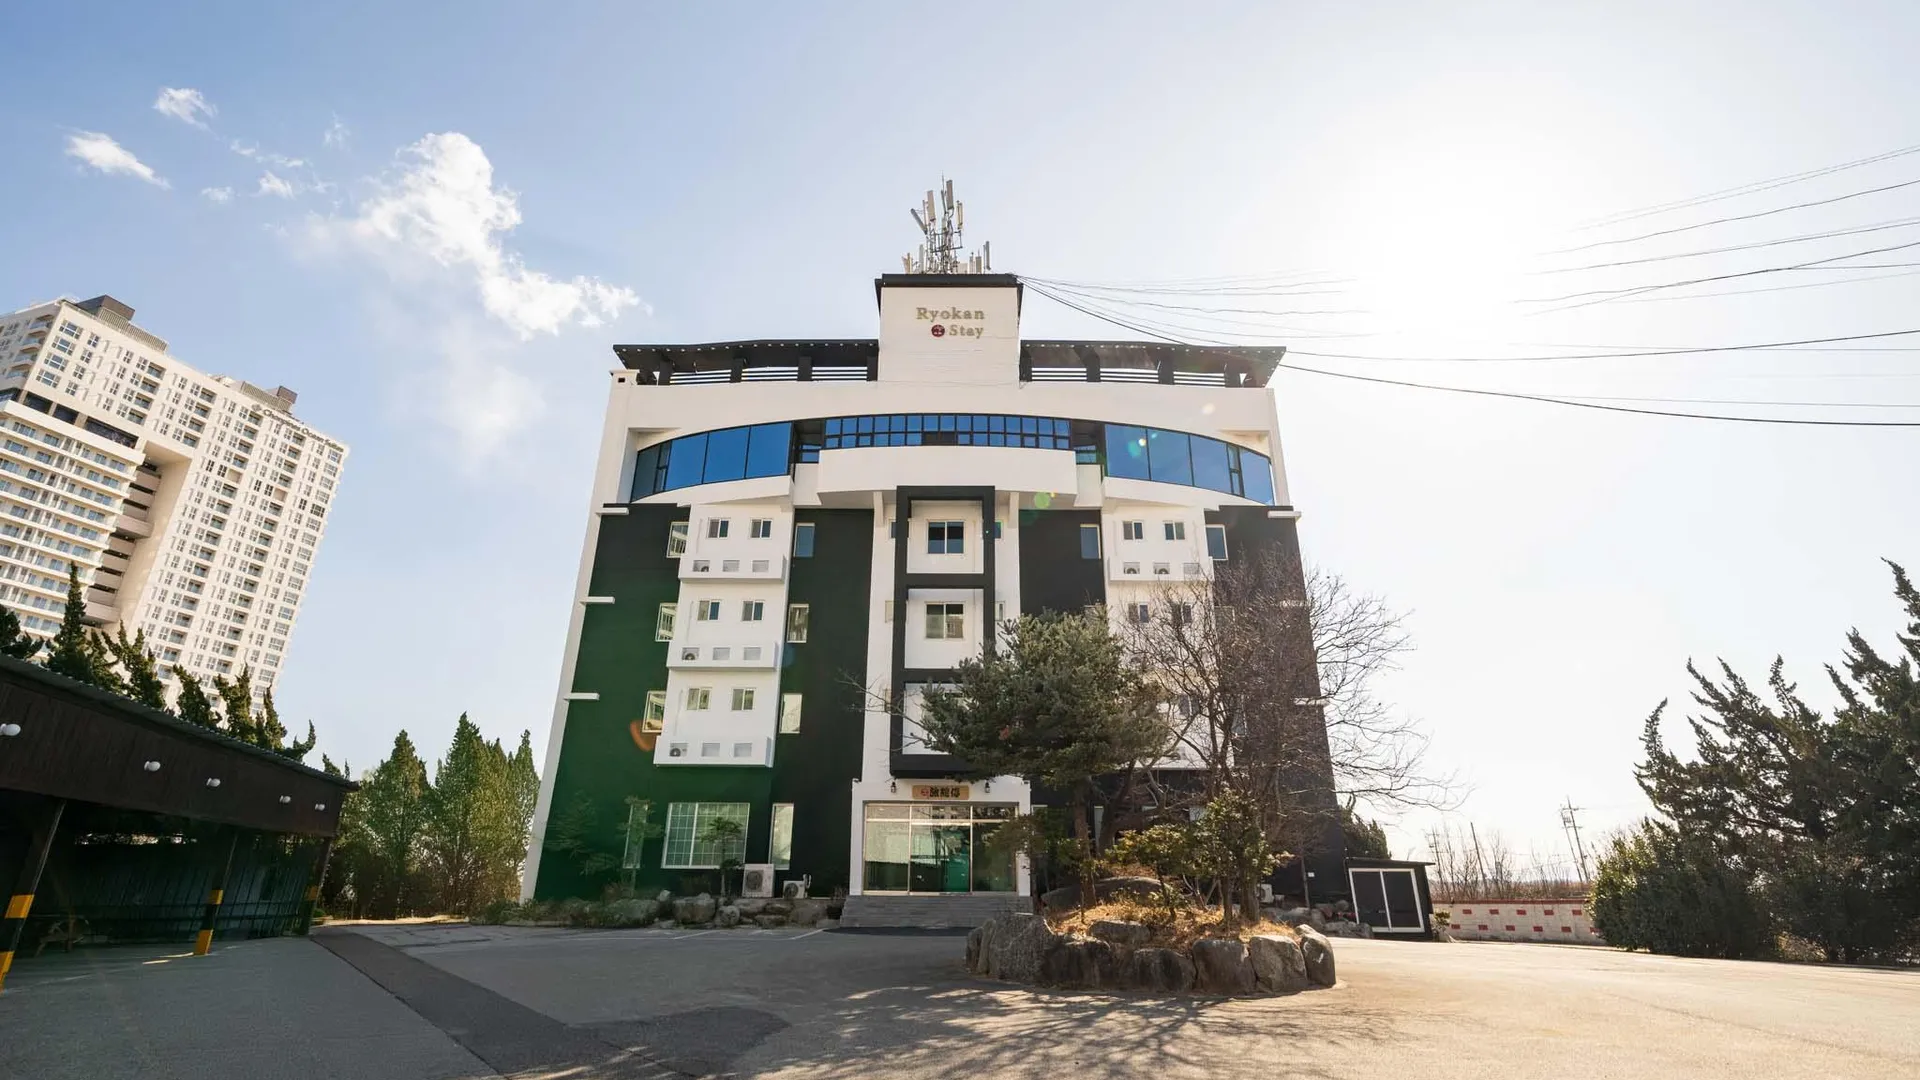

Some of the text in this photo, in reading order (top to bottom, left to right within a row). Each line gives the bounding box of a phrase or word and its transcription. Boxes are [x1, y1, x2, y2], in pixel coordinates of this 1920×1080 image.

[916, 307, 985, 322] Ryokan
[949, 325, 984, 338] Stay
[302, 428, 324, 443] Ocean
